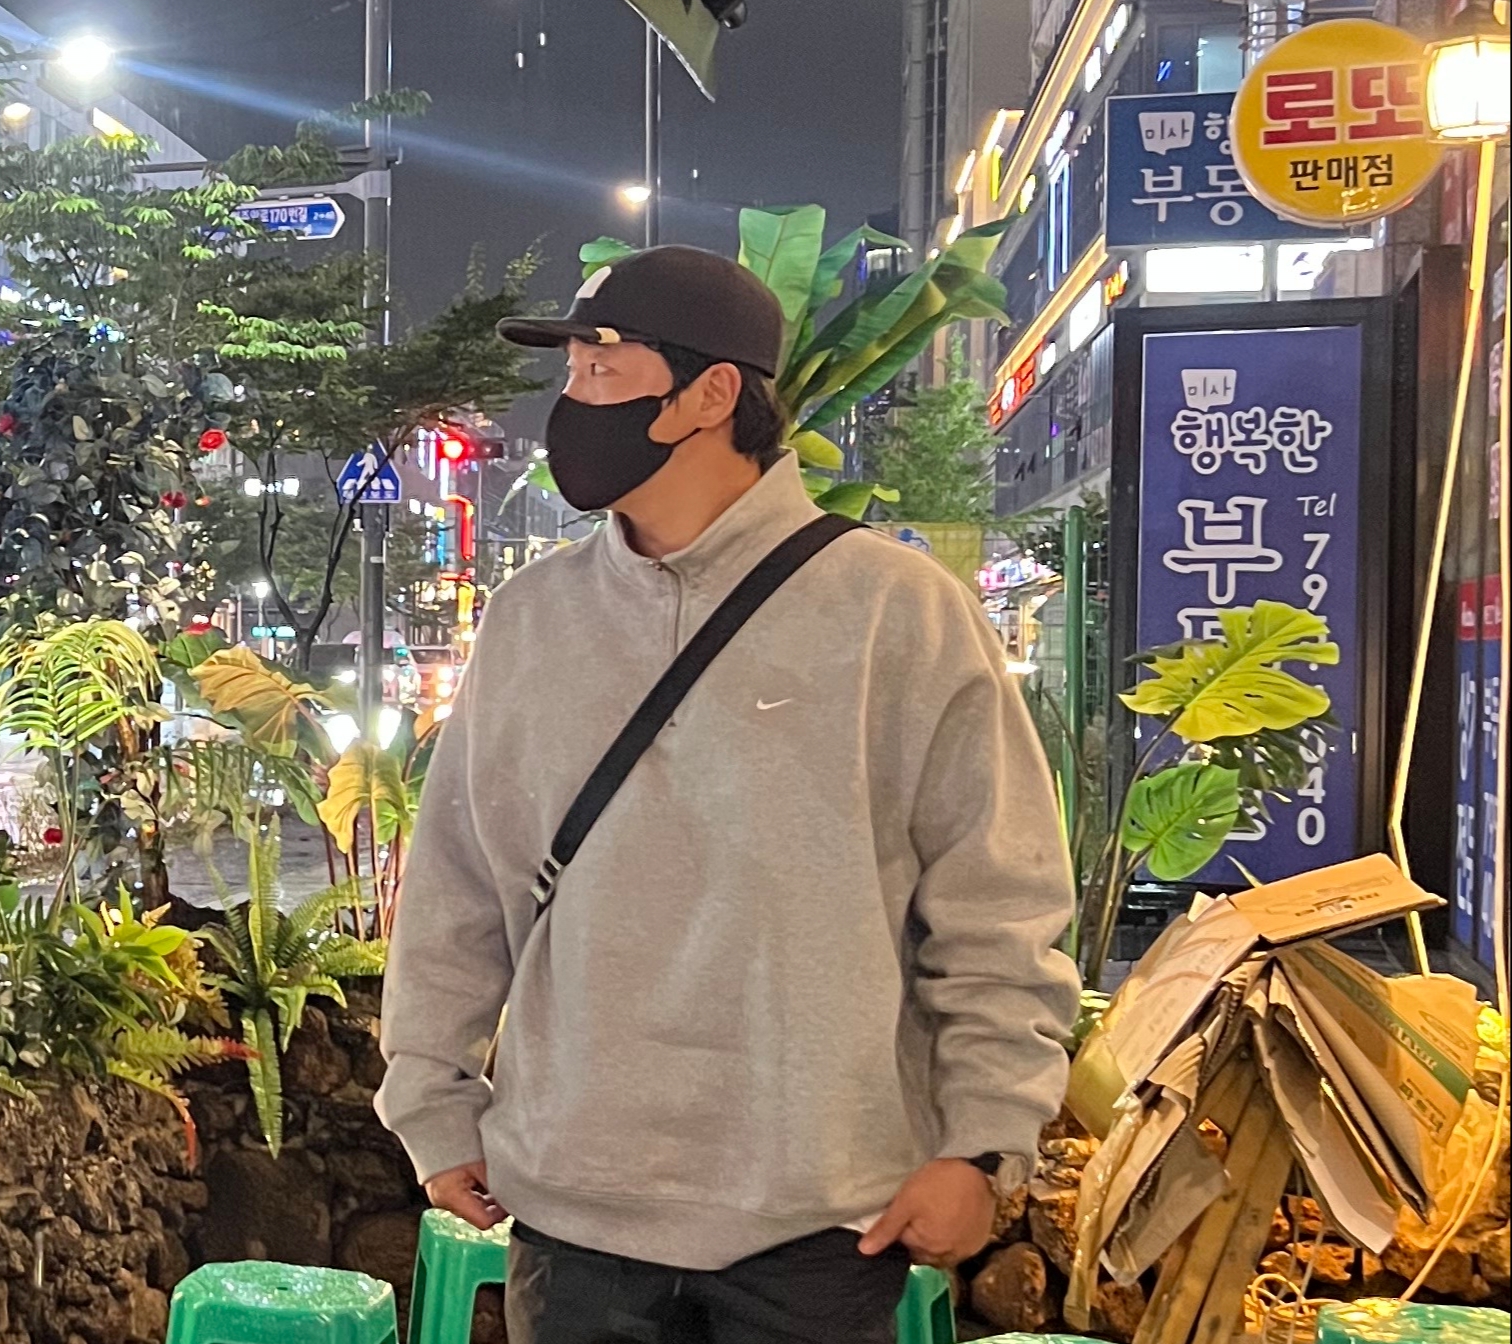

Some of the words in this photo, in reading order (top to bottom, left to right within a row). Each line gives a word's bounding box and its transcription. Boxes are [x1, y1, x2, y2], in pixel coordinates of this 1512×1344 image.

[1261, 61, 1426, 145] 로또
[1144, 119, 1190, 141] 미사
[1289, 153, 1393, 192] 판매점
[1131, 164, 1253, 227] 부동
[1187, 375, 1232, 398] 미사
[1170, 406, 1333, 475] 행복한
[1296, 492, 1337, 517] Tel
